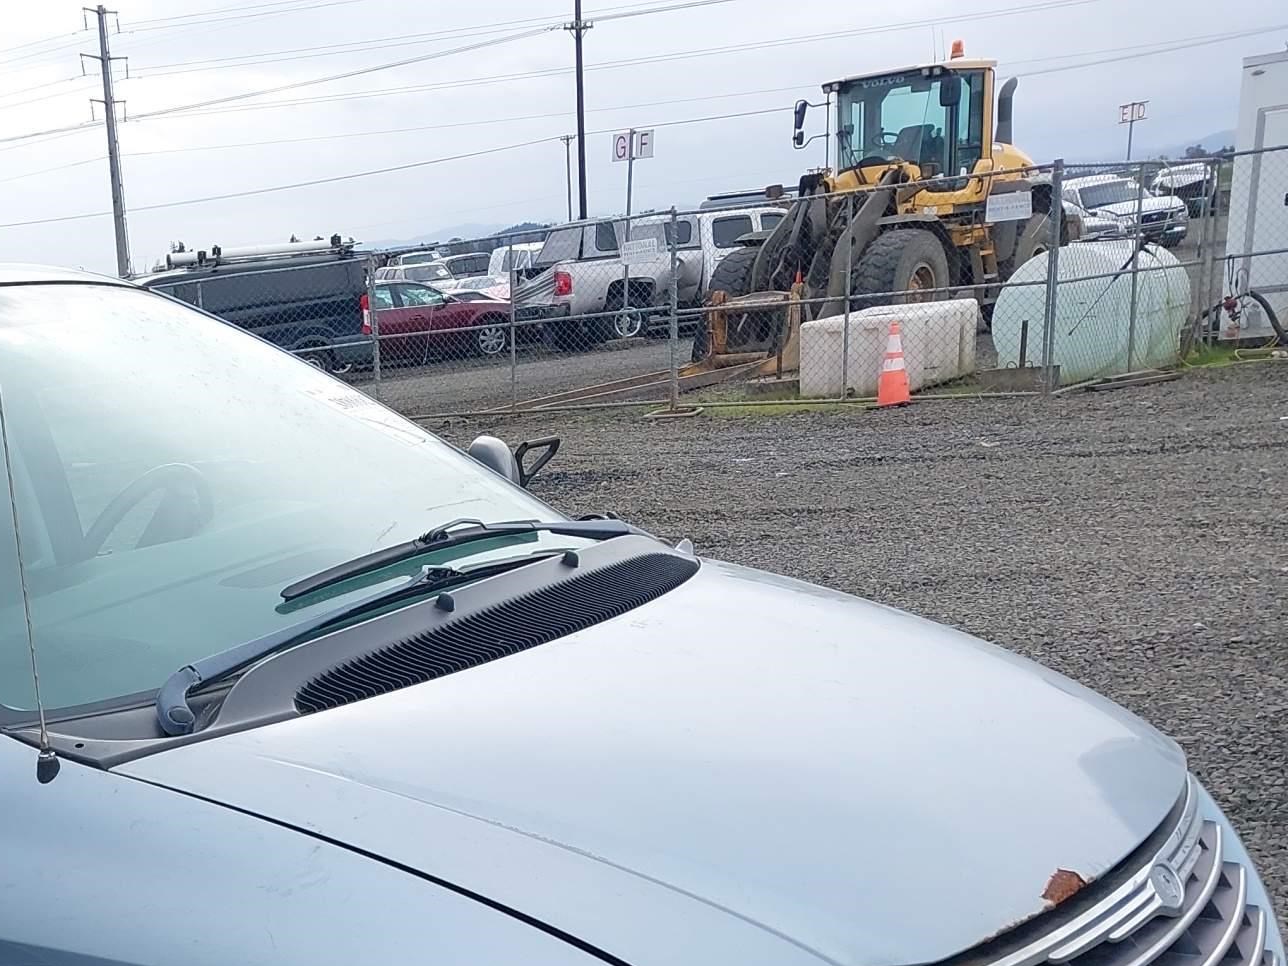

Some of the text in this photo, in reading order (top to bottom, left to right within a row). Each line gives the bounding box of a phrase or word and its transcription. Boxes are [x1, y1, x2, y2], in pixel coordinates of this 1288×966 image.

[863, 76, 905, 89] VOLVO
[1121, 102, 1146, 122] E D
[615, 132, 649, 159] G F
